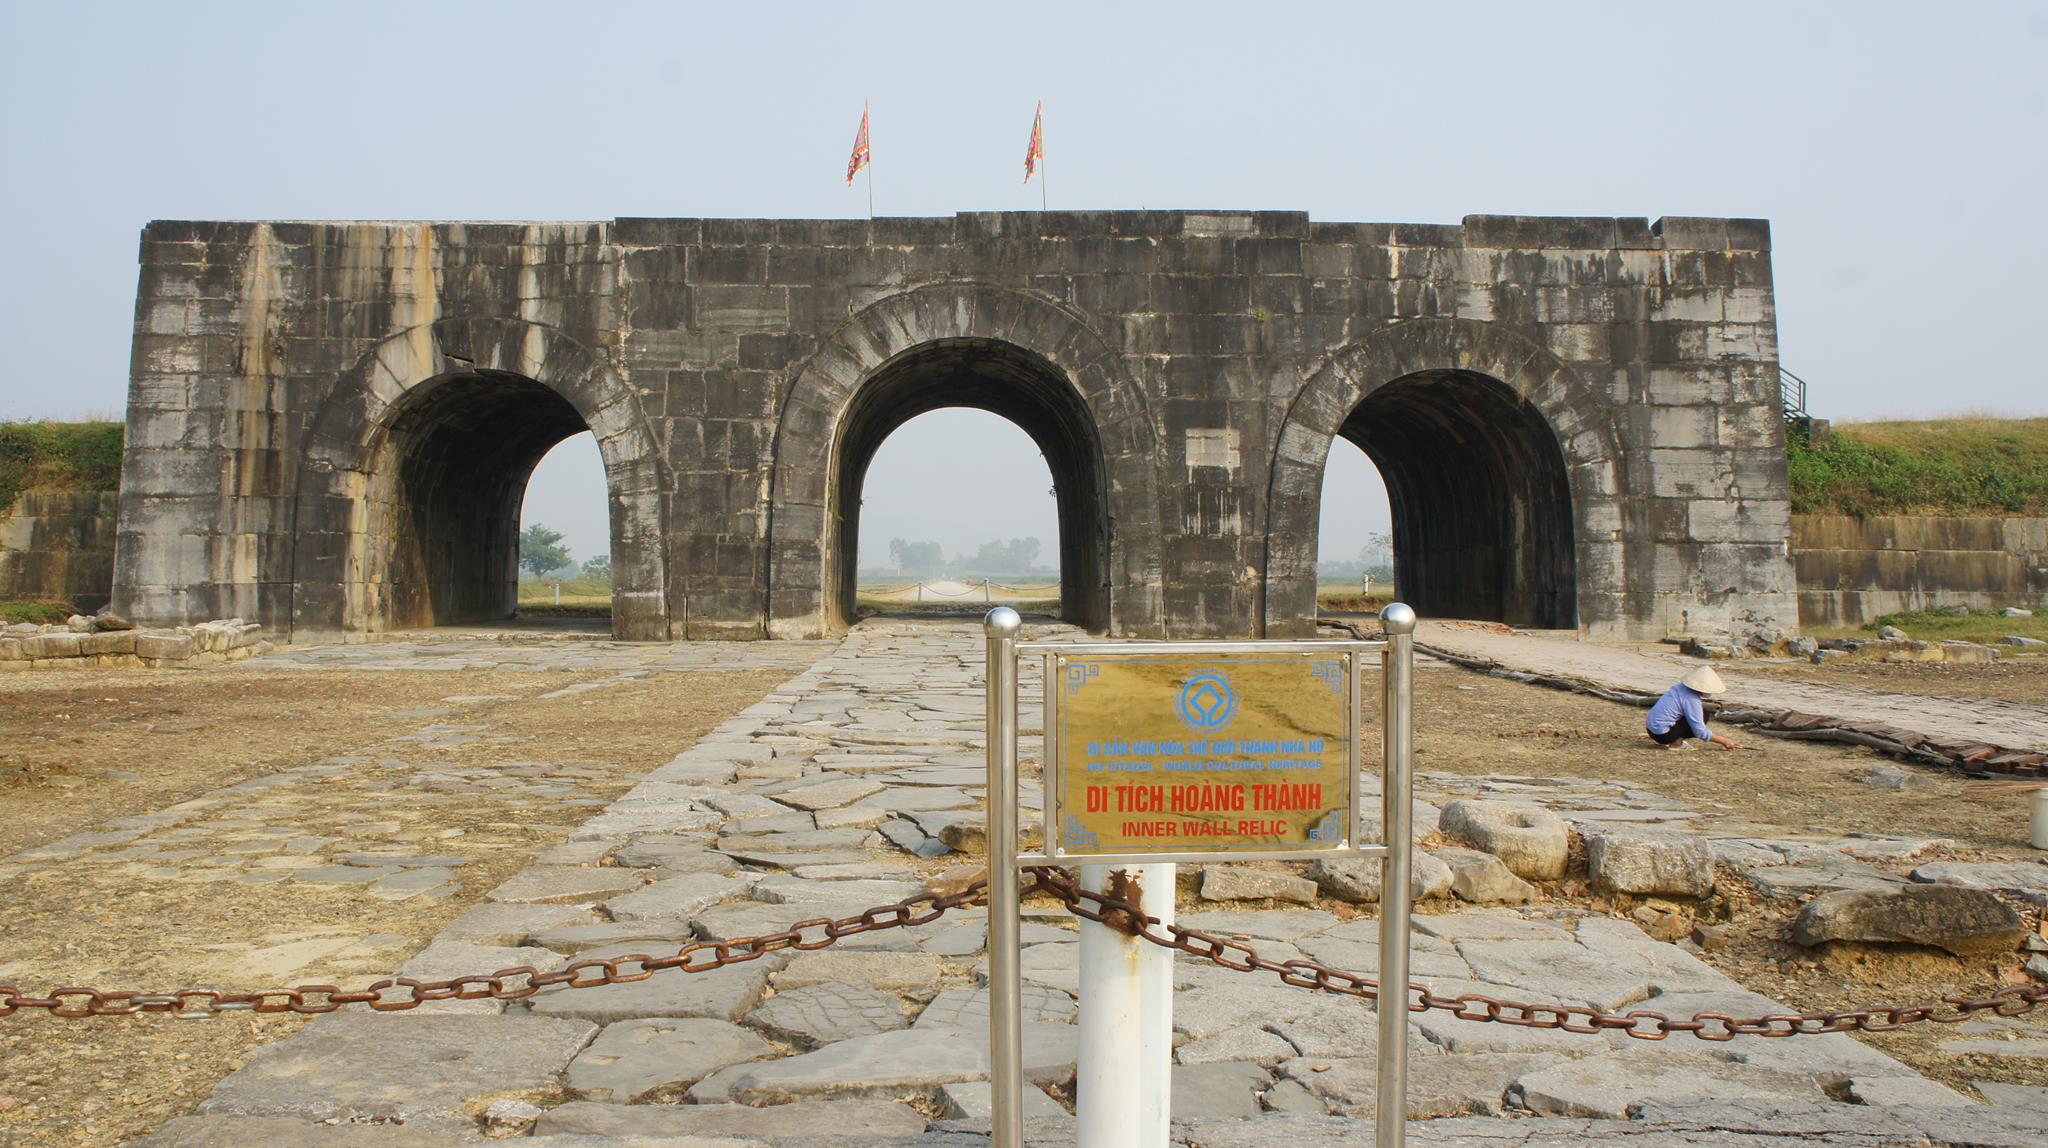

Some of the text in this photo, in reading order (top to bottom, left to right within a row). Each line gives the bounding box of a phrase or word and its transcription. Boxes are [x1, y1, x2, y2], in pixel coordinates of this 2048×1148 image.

[1087, 778, 1322, 813] DI TÍCH HOÀNG THÀNH
[1122, 820, 1288, 837] INNER WALL RELIC
